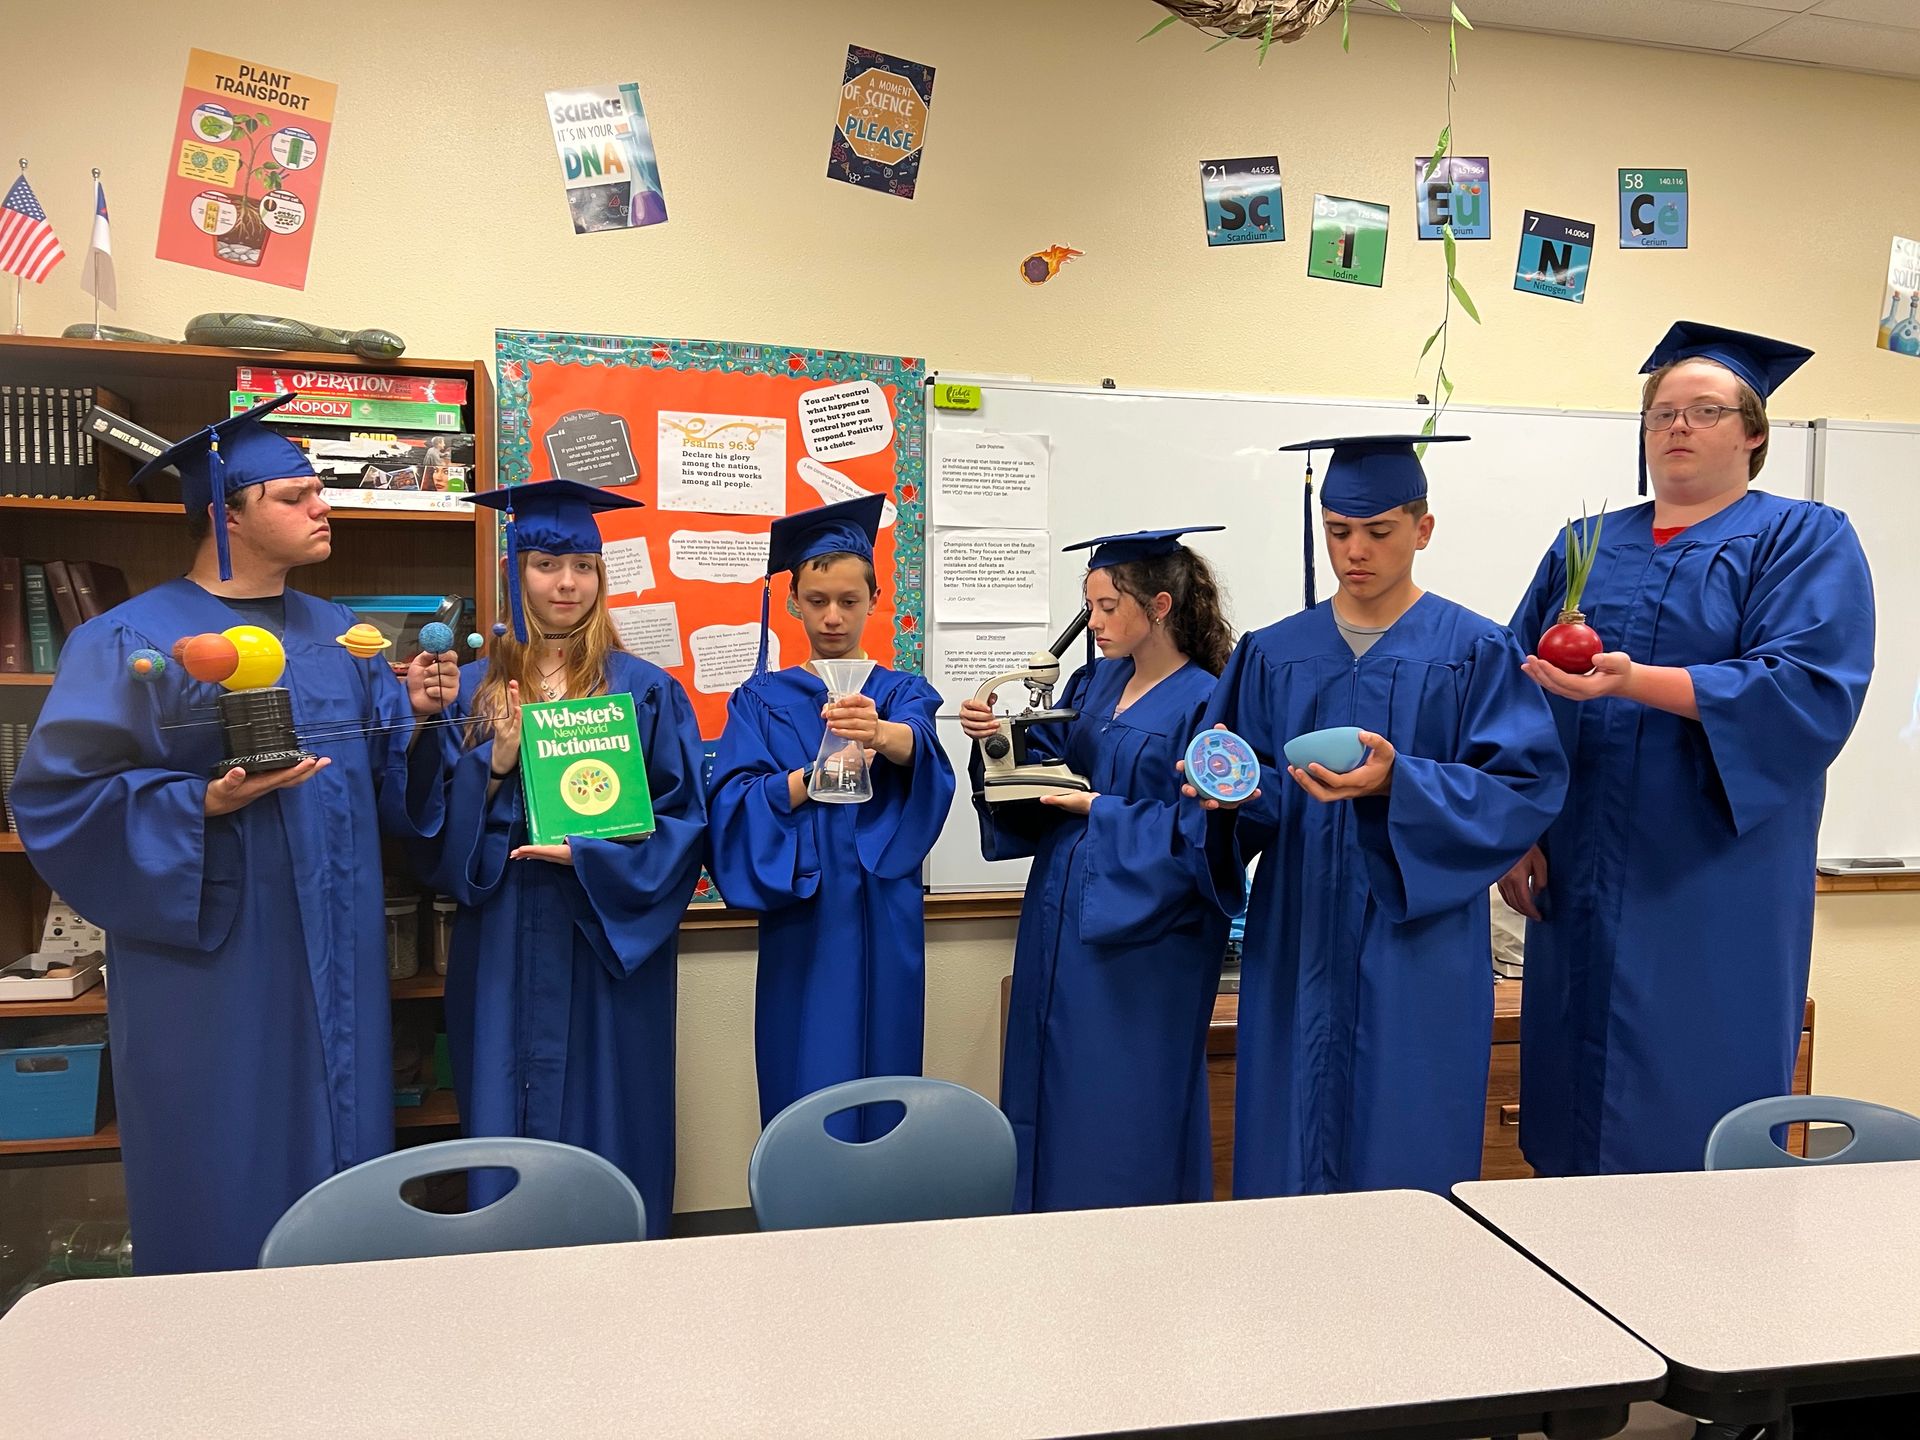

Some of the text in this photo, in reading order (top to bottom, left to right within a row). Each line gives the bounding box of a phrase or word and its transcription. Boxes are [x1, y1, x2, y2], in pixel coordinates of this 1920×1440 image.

[239, 65, 291, 89] PLANT
[215, 75, 310, 111] TRANSPORT
[870, 78, 912, 97] A MOMENT
[844, 84, 915, 116] OF SCIENCE
[554, 99, 622, 124] SCIENCE
[557, 124, 613, 142] IT'S IN YOUR
[844, 116, 913, 151] PLEASE
[564, 142, 624, 180] DNA
[1208, 165, 1227, 181] 21
[1251, 166, 1274, 174] 44.955
[1625, 174, 1643, 189] 58
[1659, 177, 1684, 185] 140.116
[1220, 186, 1271, 230] Sc
[1428, 183, 1481, 226] Eu
[1630, 194, 1679, 235] Ce
[1436, 227, 1473, 236] Epium
[1529, 217, 1539, 231] 7
[1227, 231, 1267, 242] Scandium
[1564, 227, 1589, 239] 14.0064
[1641, 238, 1667, 246] Cerium
[1537, 240, 1572, 286] N
[1333, 270, 1358, 281] Iodine
[1533, 281, 1566, 295] Nitrogen
[293, 372, 393, 392] OPERATION
[822, 393, 840, 402] can't
[842, 388, 869, 398] control
[807, 406, 827, 415] what
[828, 401, 859, 411] happens
[578, 412, 599, 420] Positive
[811, 424, 839, 433] control
[841, 420, 856, 428] how
[814, 424, 883, 443] respond. Positivity
[683, 439, 755, 451] Psalms 96:3
[830, 441, 855, 450] choice.
[730, 454, 750, 462] glory
[697, 470, 735, 478] wondrous
[728, 463, 760, 471] nations,
[532, 703, 624, 730] Webster's
[554, 723, 608, 738] New World
[537, 735, 630, 758] Dictionary
